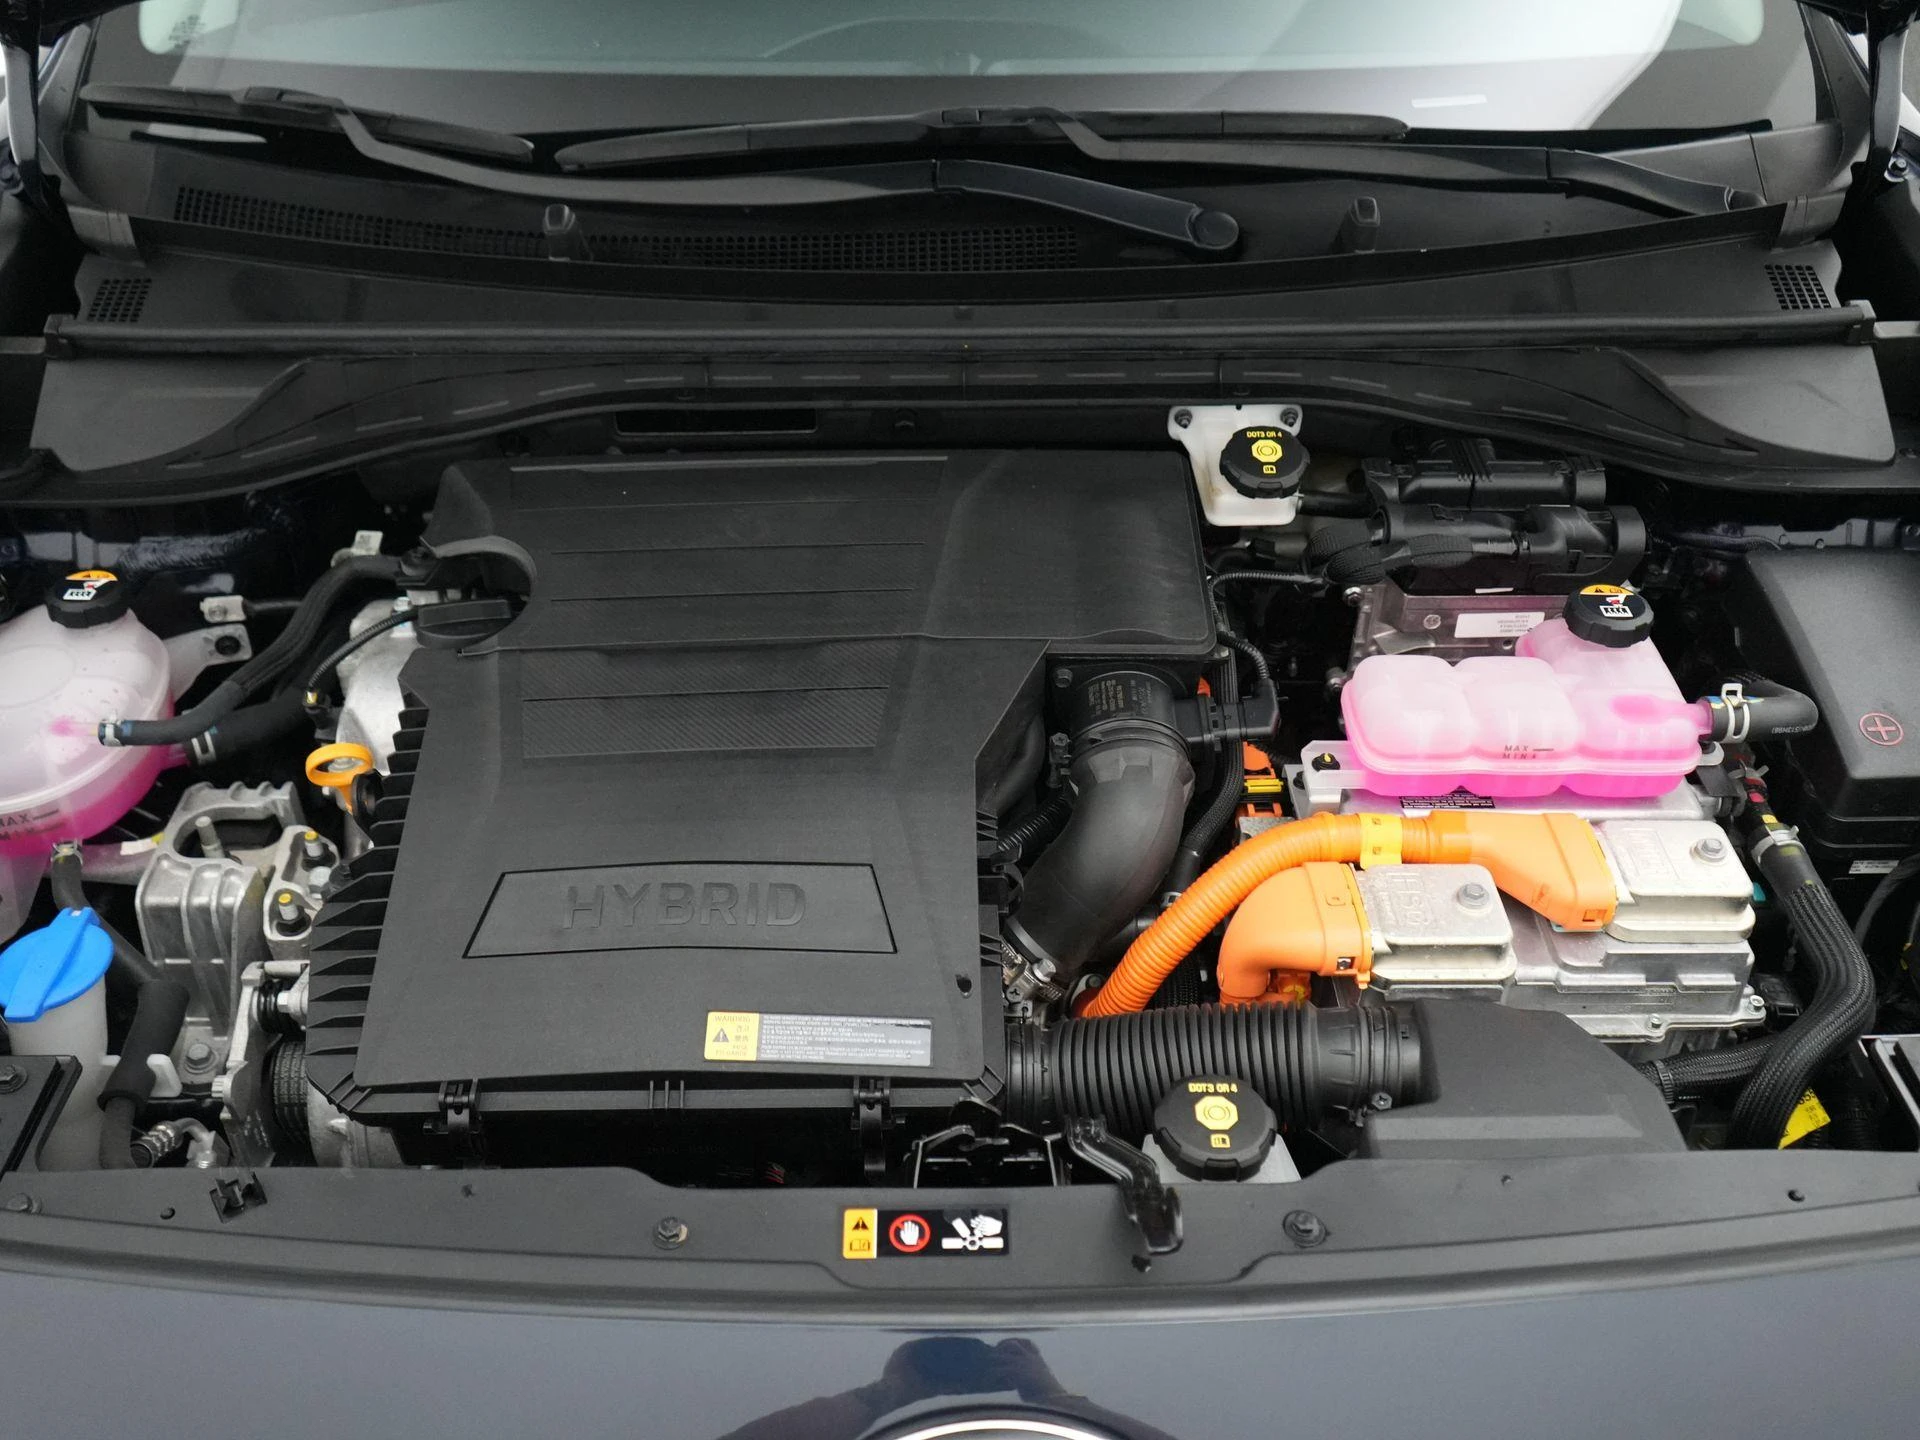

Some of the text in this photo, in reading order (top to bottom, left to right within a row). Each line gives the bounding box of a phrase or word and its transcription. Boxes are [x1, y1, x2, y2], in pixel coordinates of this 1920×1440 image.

[1246, 430, 1283, 438] DOT3 OR 4
[1503, 744, 1528, 752] MAX
[562, 881, 806, 929] HYBRID
[1188, 1082, 1238, 1093] DOT3 OR 4
